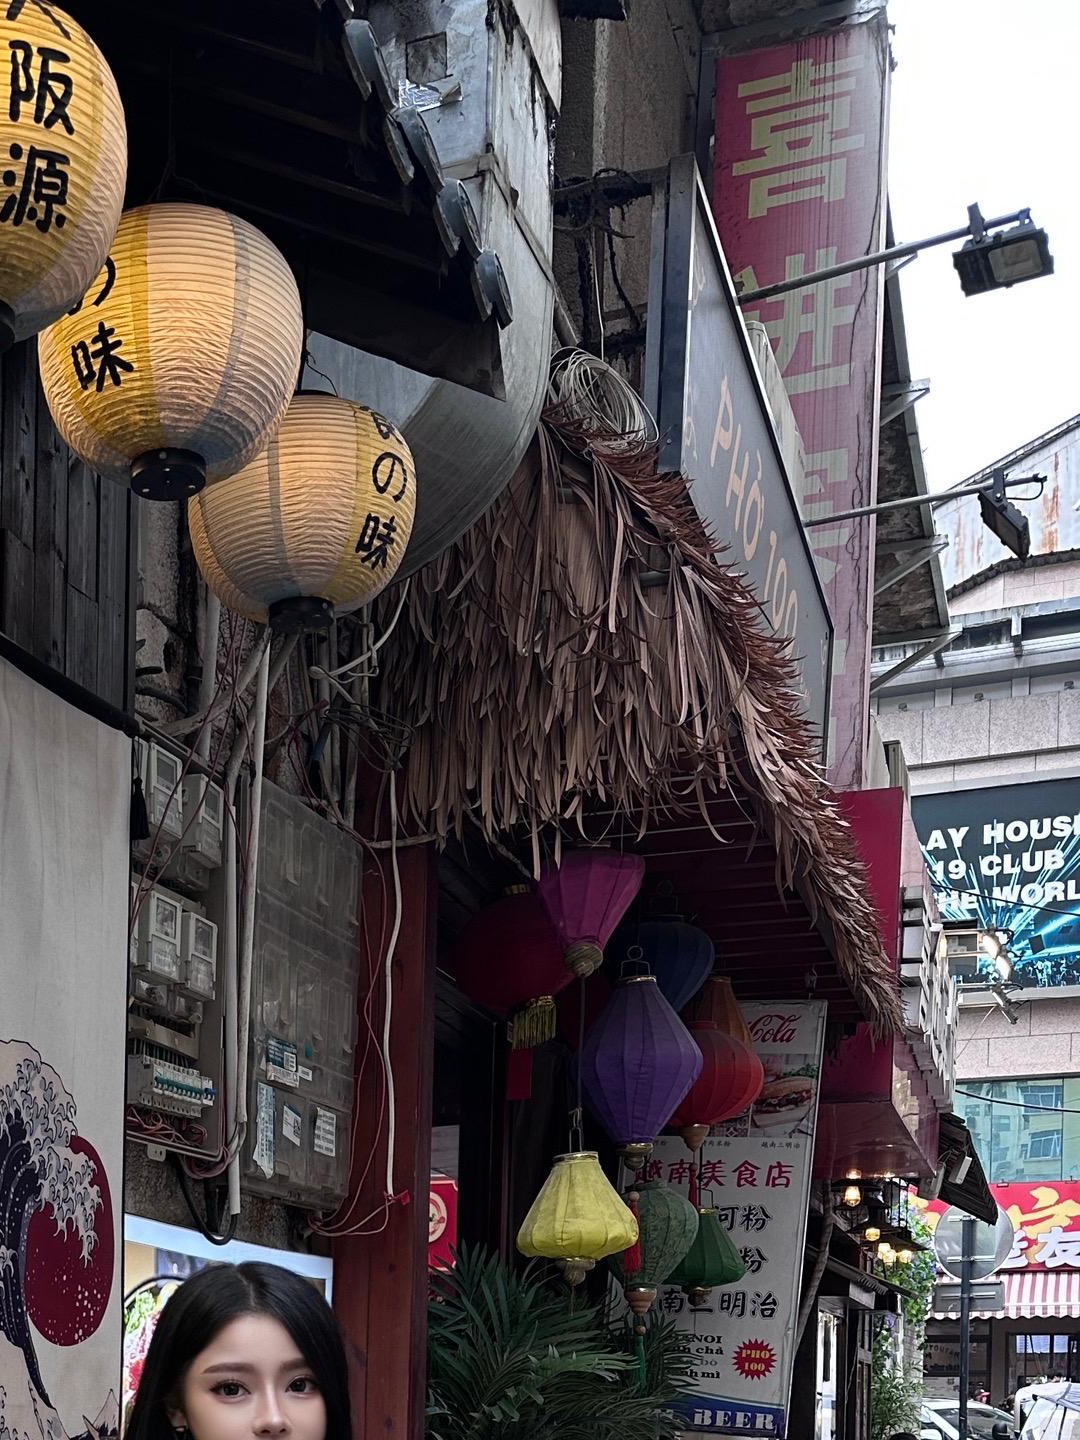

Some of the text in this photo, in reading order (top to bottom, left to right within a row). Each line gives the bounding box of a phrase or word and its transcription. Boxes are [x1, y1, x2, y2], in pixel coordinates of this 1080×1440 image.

[920, 826, 970, 850] AY
[980, 849, 1066, 877] CLUB
[933, 889, 980, 912] HE
[693, 1407, 776, 1432] BEER
